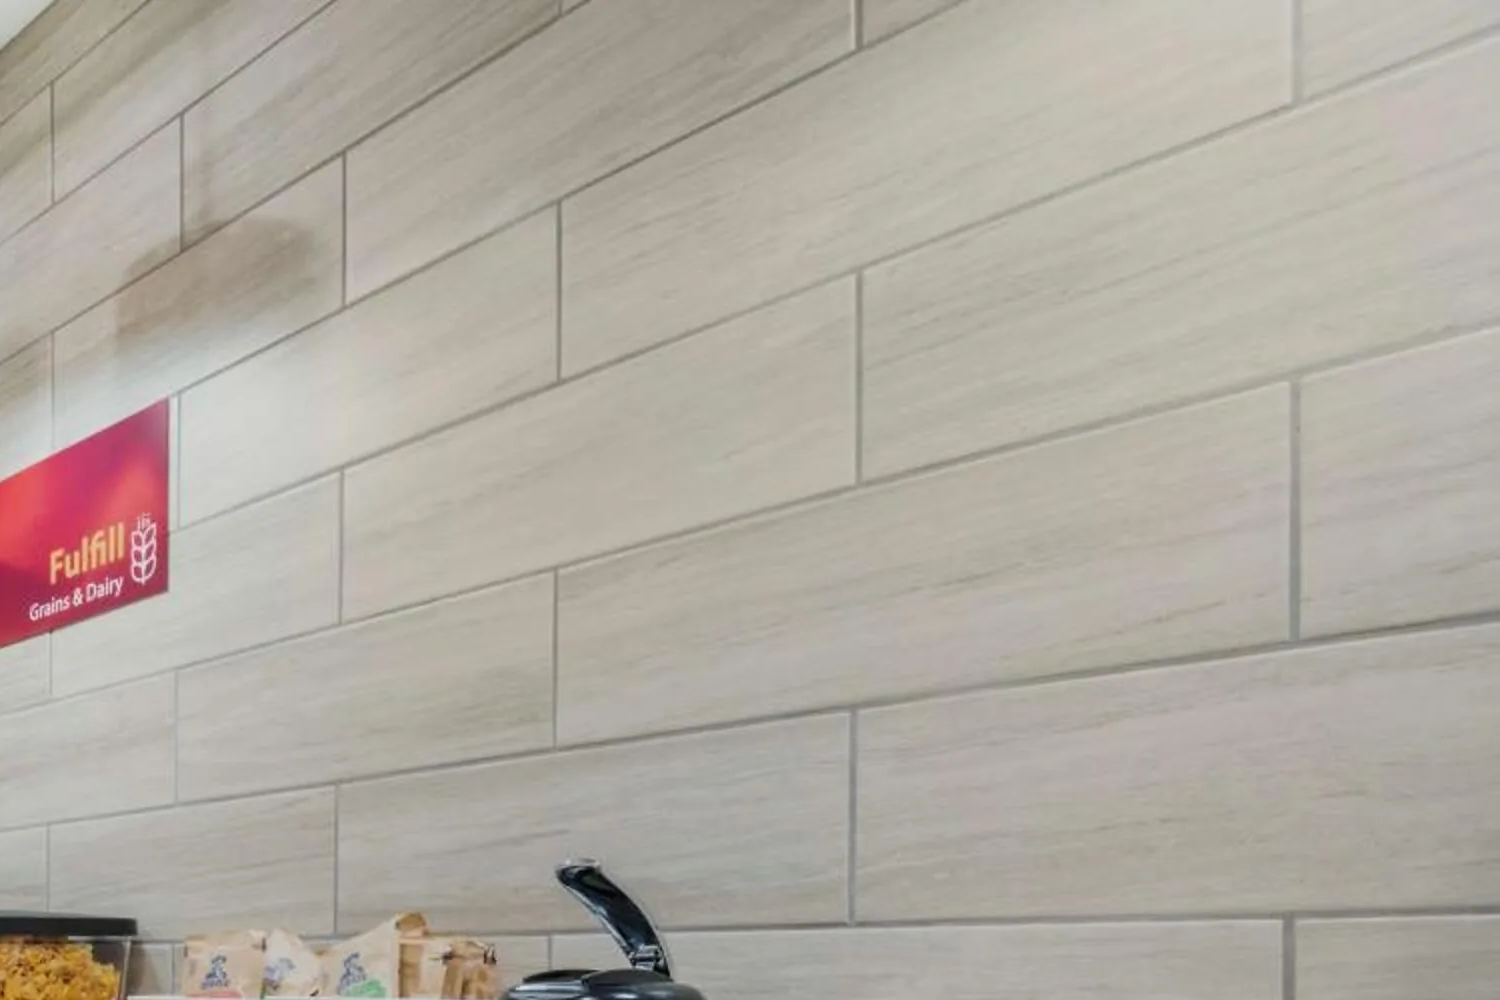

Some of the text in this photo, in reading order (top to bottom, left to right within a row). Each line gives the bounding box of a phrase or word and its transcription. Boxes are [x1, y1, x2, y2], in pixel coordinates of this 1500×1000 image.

[49, 521, 125, 585] Fulfill
[29, 576, 124, 621] Grains & Dairy
